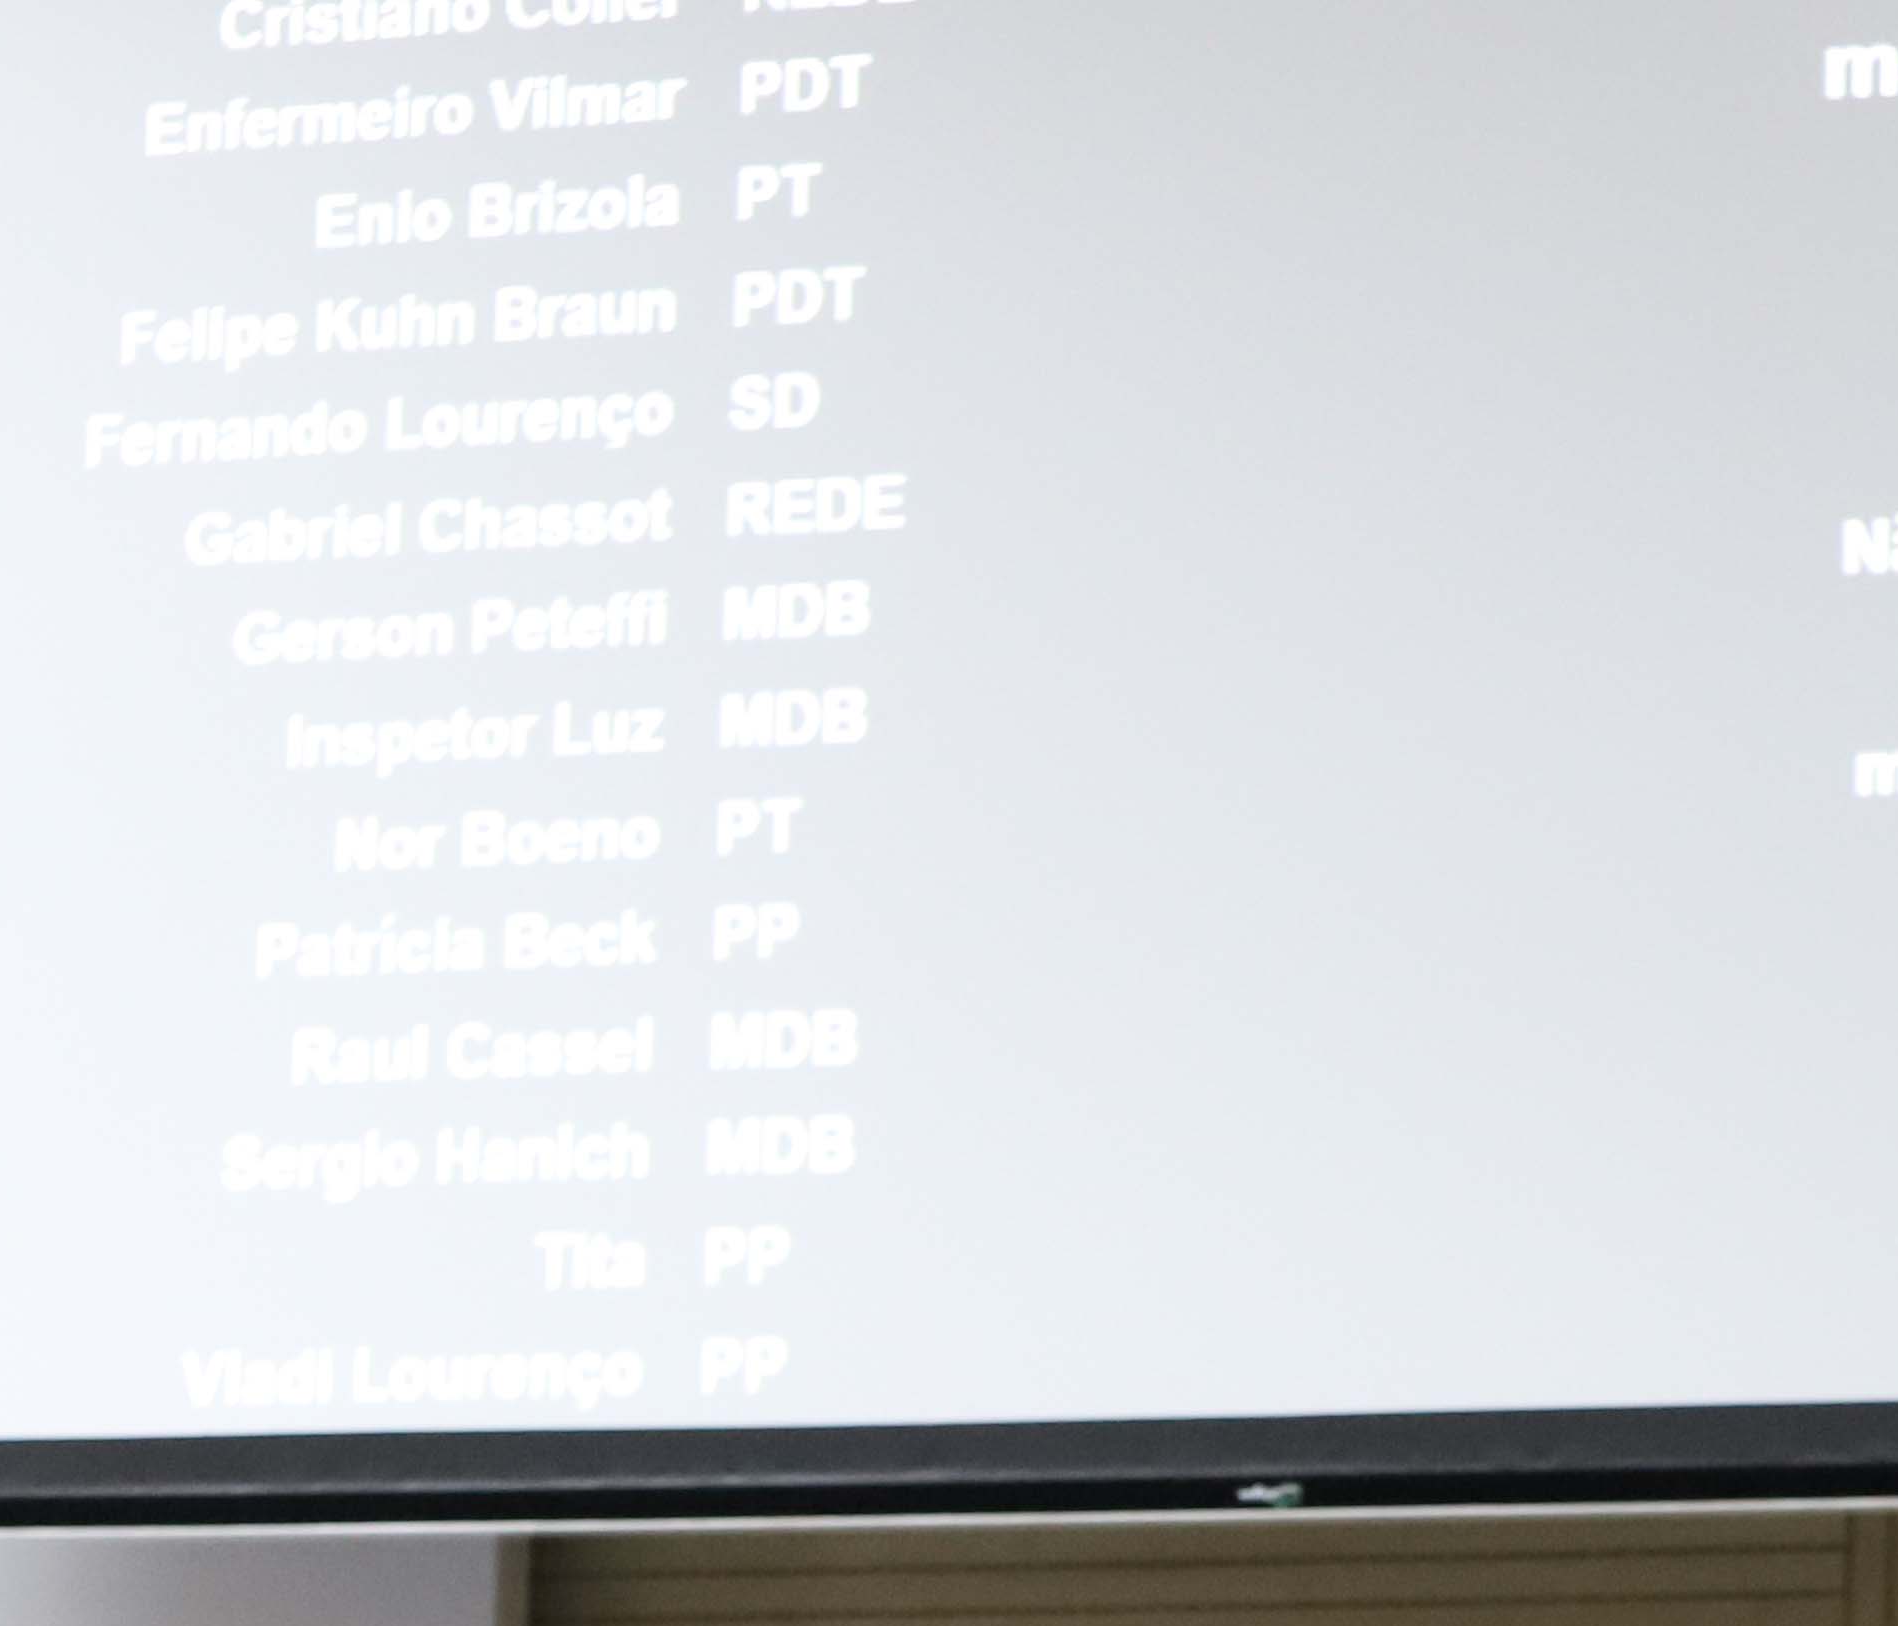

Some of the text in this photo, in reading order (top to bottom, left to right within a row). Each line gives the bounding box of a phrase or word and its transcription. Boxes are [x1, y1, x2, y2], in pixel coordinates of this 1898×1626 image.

[220, 0, 490, 49] Cristiano
[145, 53, 873, 156] Enfermeiro Vilmar PDT
[315, 162, 823, 248] Enio Brizola PT
[121, 265, 867, 373] Felipe Kuhn Braun PDT
[86, 372, 821, 468] Fernando Lourenço SD
[185, 474, 907, 565] Gabriel Chassot REDE
[232, 610, 455, 665] Gerson
[723, 580, 871, 640] MDB
[287, 687, 868, 778] Inspetor Luz MDB
[335, 797, 803, 872] Nor Boeno PT
[503, 908, 656, 968] Beck
[713, 902, 800, 961] PP
[291, 1008, 859, 1086] Raul Cassel MDB
[436, 1120, 650, 1184] Hanich
[706, 1113, 855, 1176] MDB
[535, 1224, 791, 1291] Tita PP
[353, 1346, 643, 1411] Lourenço
[701, 1336, 788, 1395] PP
